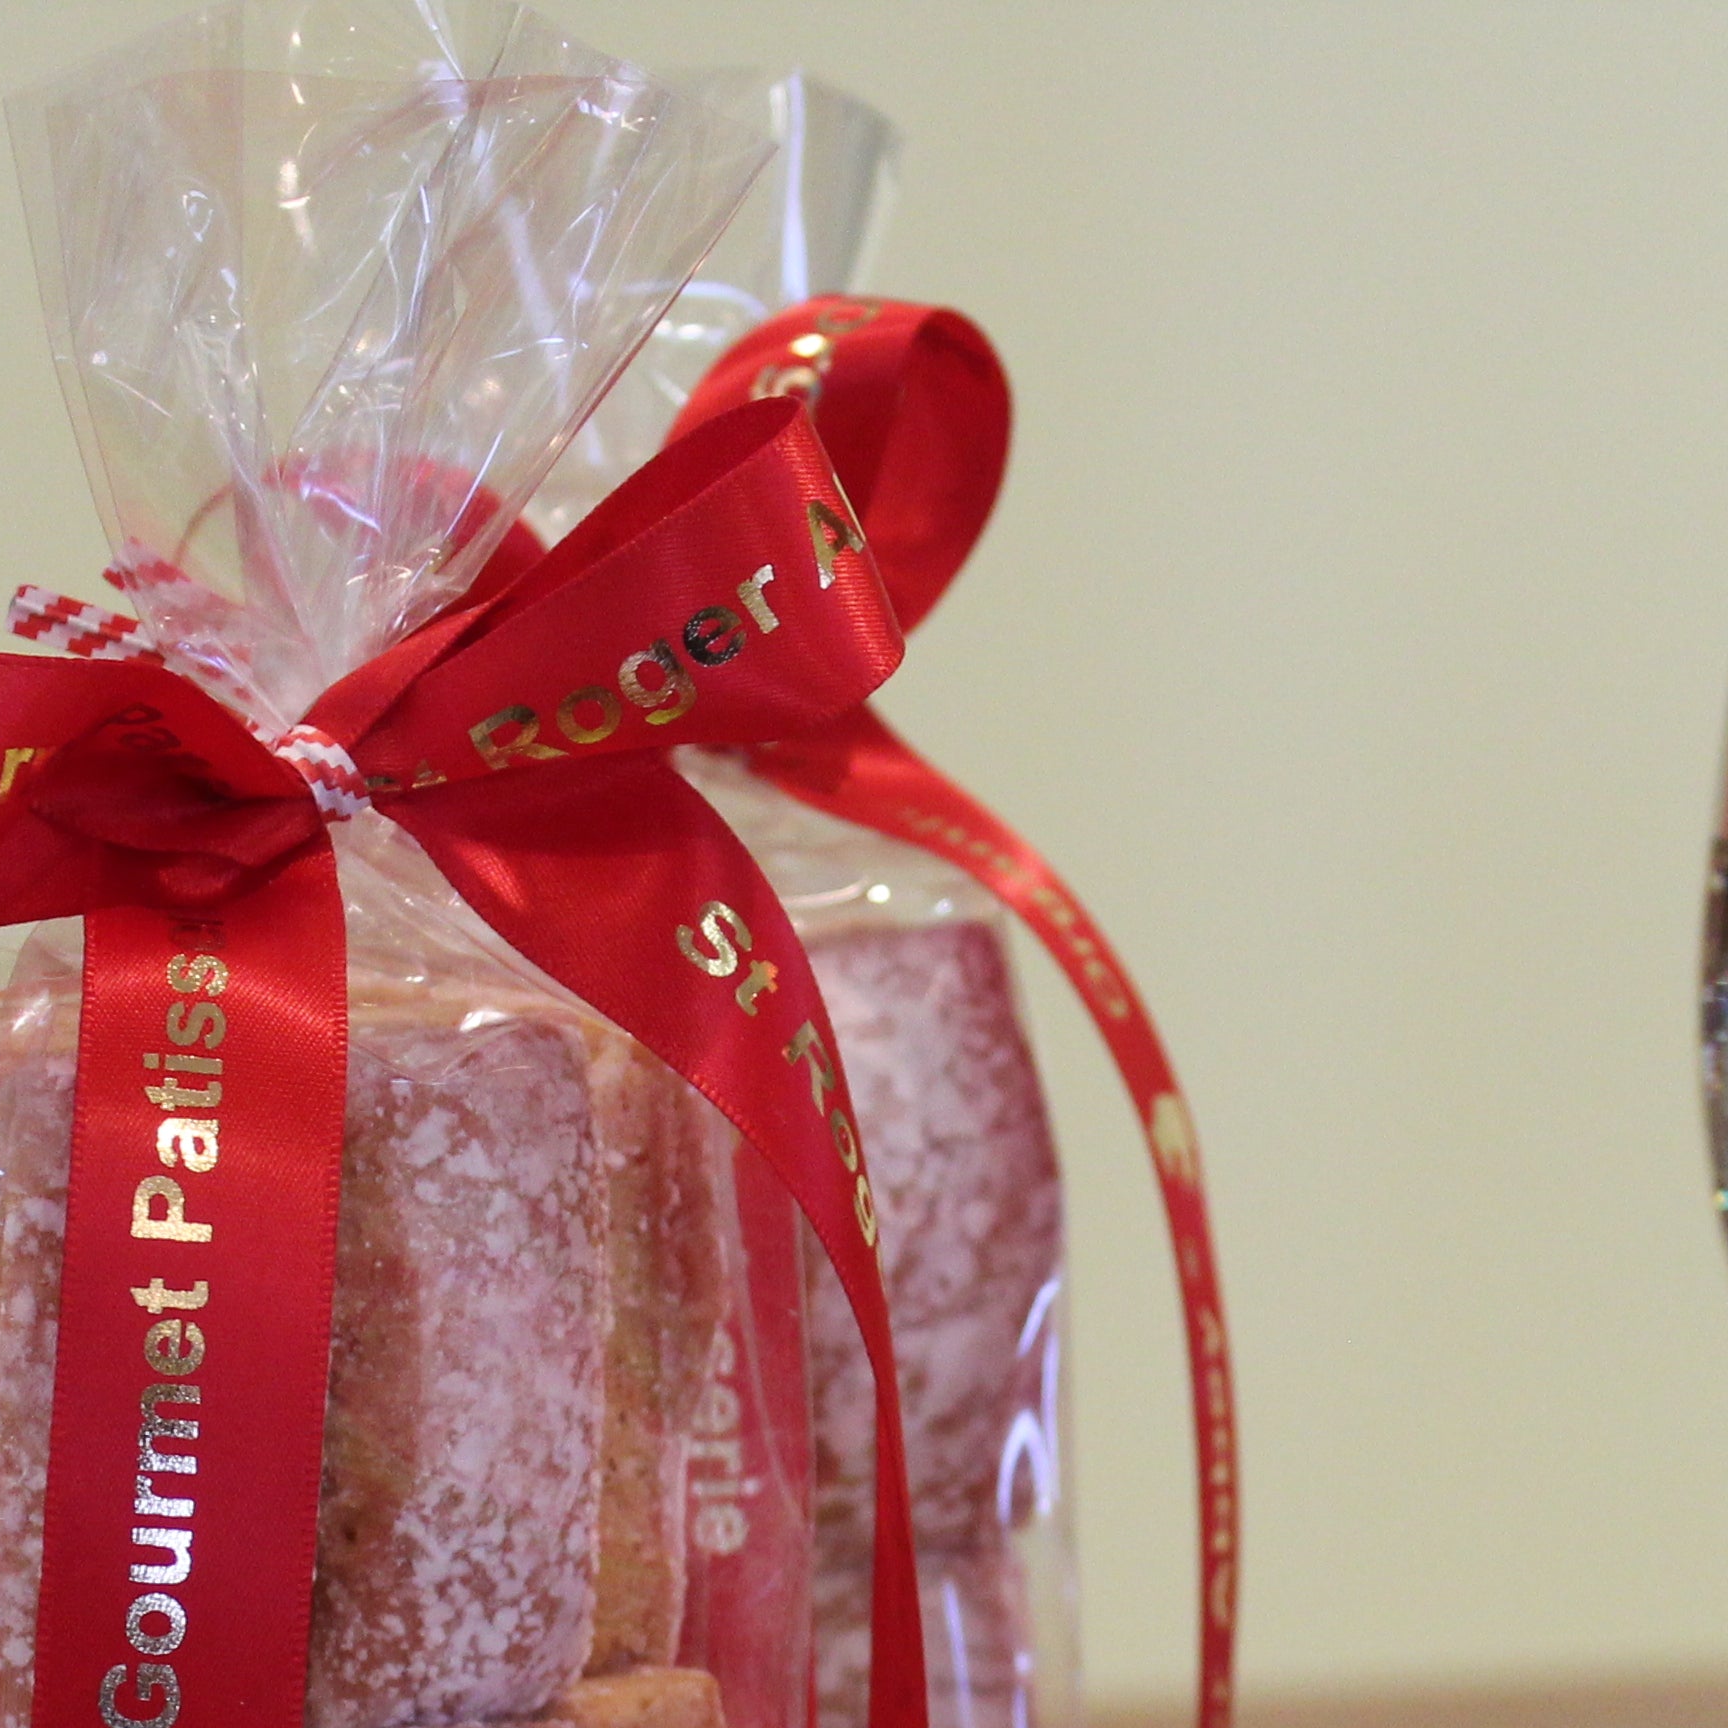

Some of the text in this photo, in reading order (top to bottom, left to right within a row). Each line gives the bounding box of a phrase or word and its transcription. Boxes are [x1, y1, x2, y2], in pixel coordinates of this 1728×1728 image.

[468, 563, 779, 761] Roger
[130, 921, 229, 1243] Patiss
[677, 901, 884, 1285] St Rog
